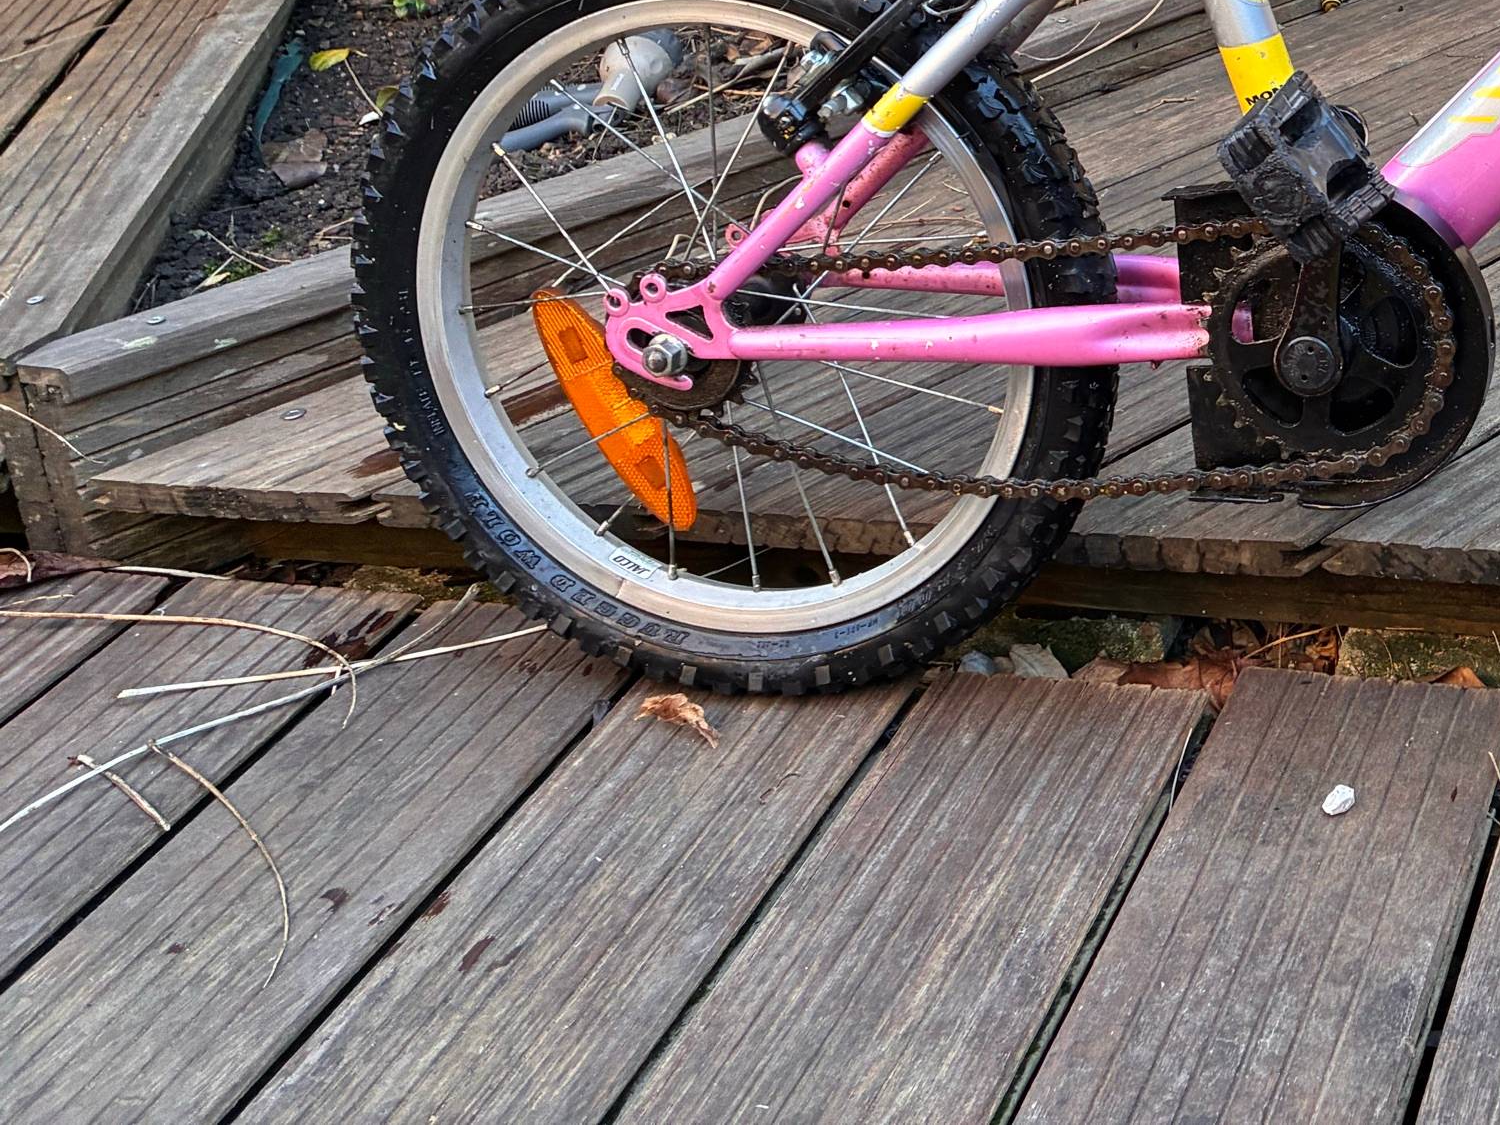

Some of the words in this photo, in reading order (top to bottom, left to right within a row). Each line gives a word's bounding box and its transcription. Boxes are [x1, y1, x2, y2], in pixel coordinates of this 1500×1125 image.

[464, 489, 542, 570] WOLF
[612, 554, 652, 575] JALCO
[549, 574, 690, 646] RUGGED
